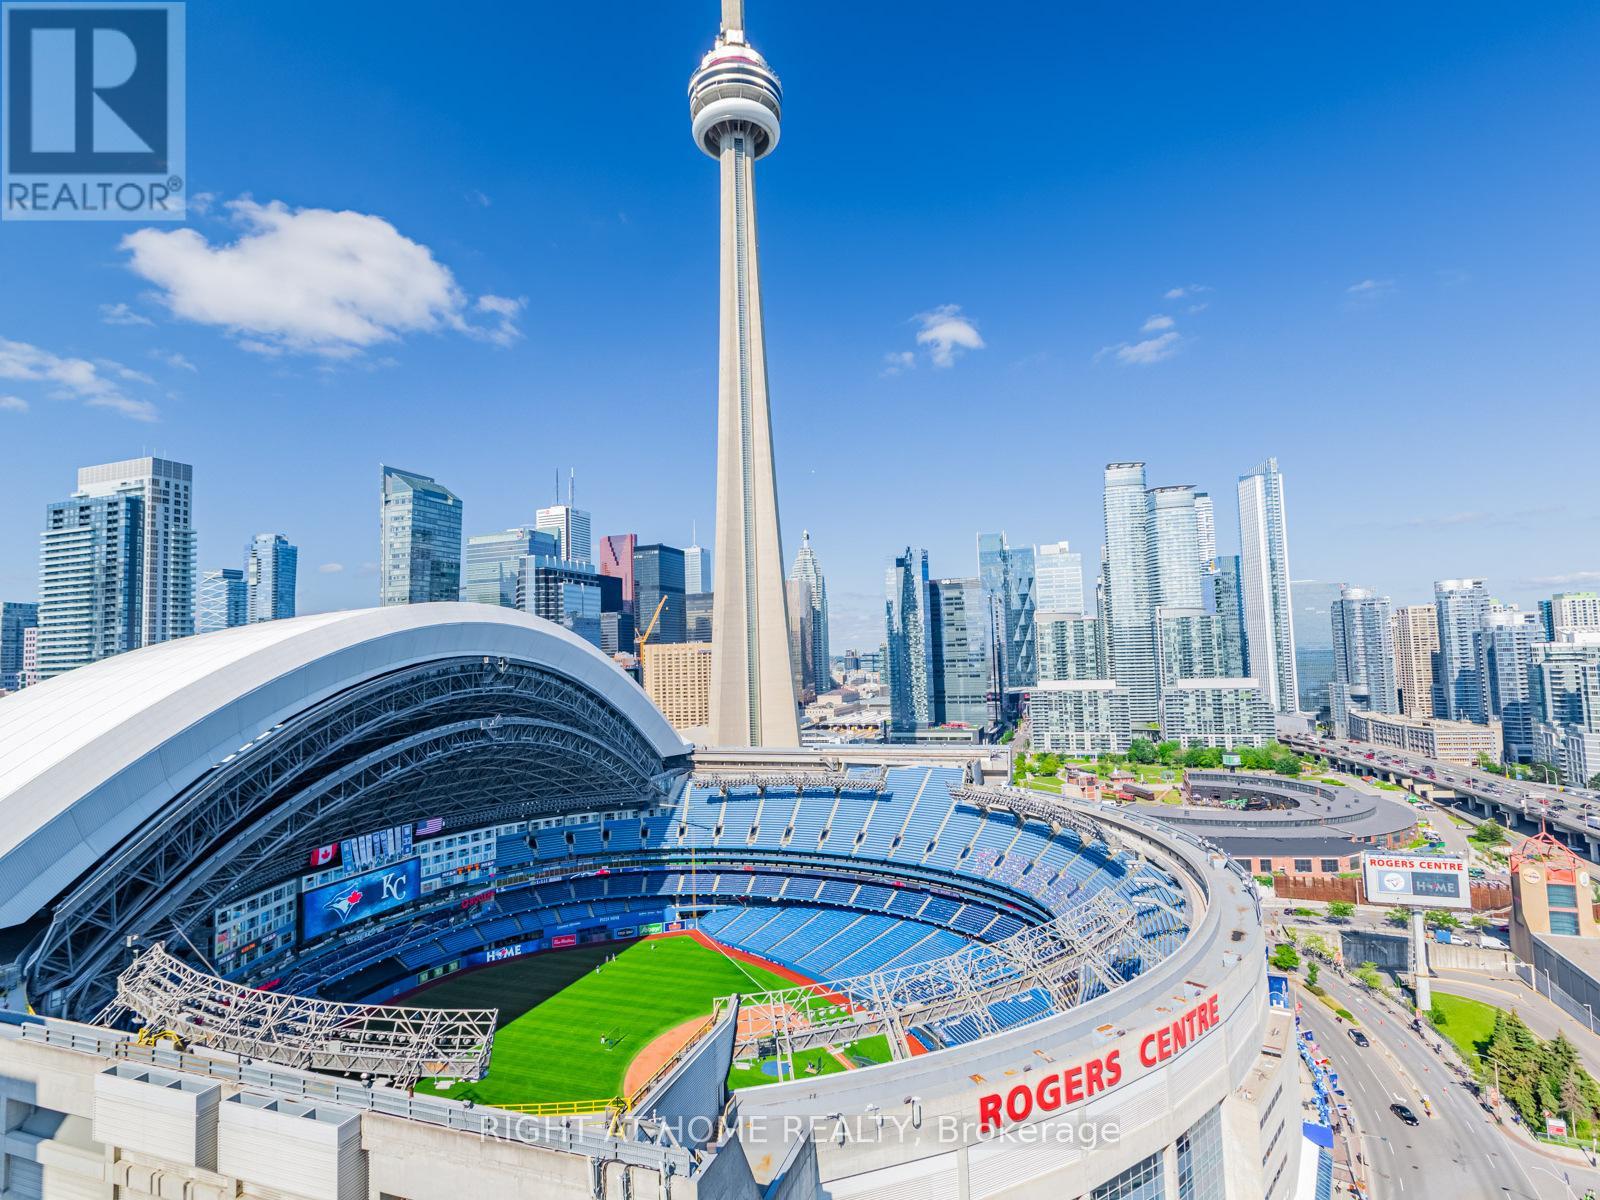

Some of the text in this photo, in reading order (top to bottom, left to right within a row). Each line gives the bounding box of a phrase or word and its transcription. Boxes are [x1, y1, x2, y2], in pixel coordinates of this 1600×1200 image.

[1370, 859, 1463, 871] ROGERS CENTRE
[381, 872, 406, 900] KC
[979, 994, 1220, 1134] ROGERS CENTRE
